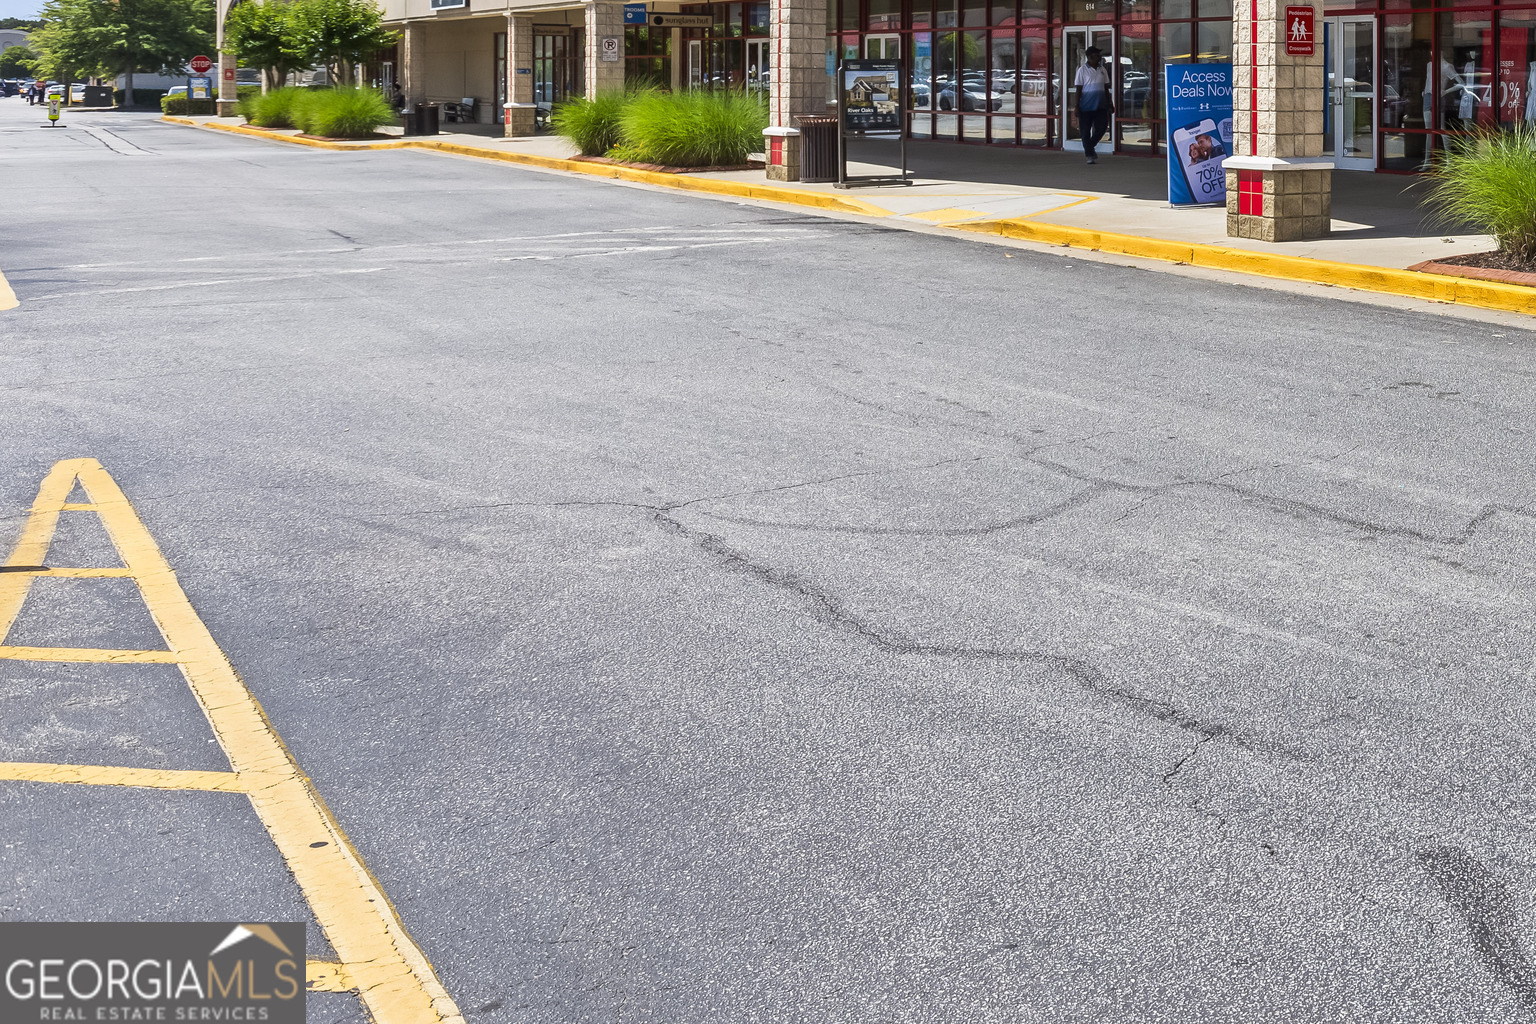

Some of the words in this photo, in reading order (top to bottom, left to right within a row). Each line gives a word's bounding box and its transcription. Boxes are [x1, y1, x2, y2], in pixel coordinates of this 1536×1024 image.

[1181, 70, 1226, 83] Access
[1172, 84, 1205, 98] Deals
[1196, 165, 1223, 183] 70%
[1202, 176, 1225, 194] OFF
